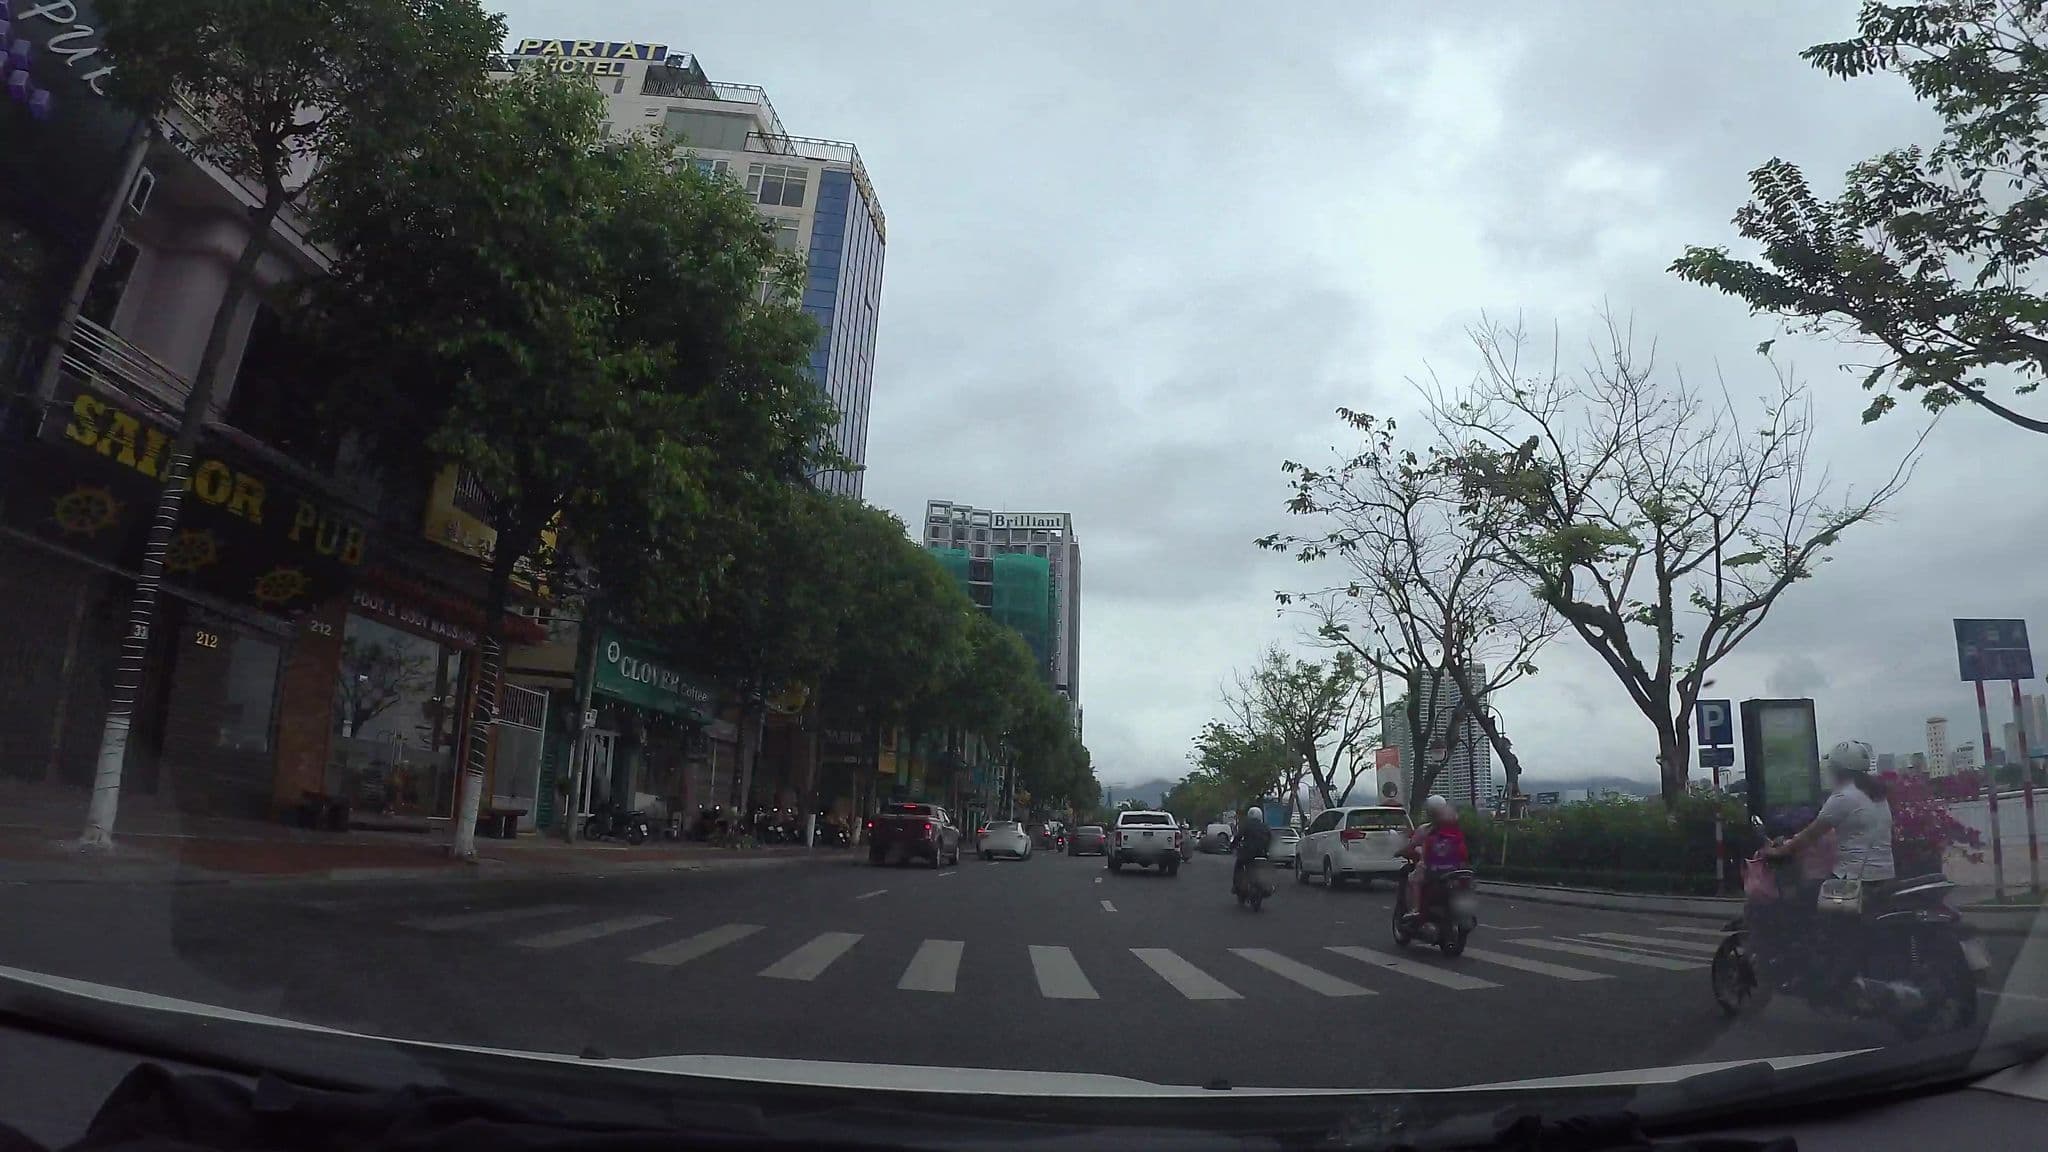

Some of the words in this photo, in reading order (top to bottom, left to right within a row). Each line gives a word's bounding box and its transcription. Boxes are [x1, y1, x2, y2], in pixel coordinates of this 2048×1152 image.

[519, 38, 665, 60] PARIAT
[545, 56, 623, 76] HOTEL
[994, 515, 1061, 528] Brilliant
[288, 499, 366, 567] PUB
[310, 619, 332, 636] 212
[195, 629, 219, 648] 212
[1703, 705, 1724, 740] P
